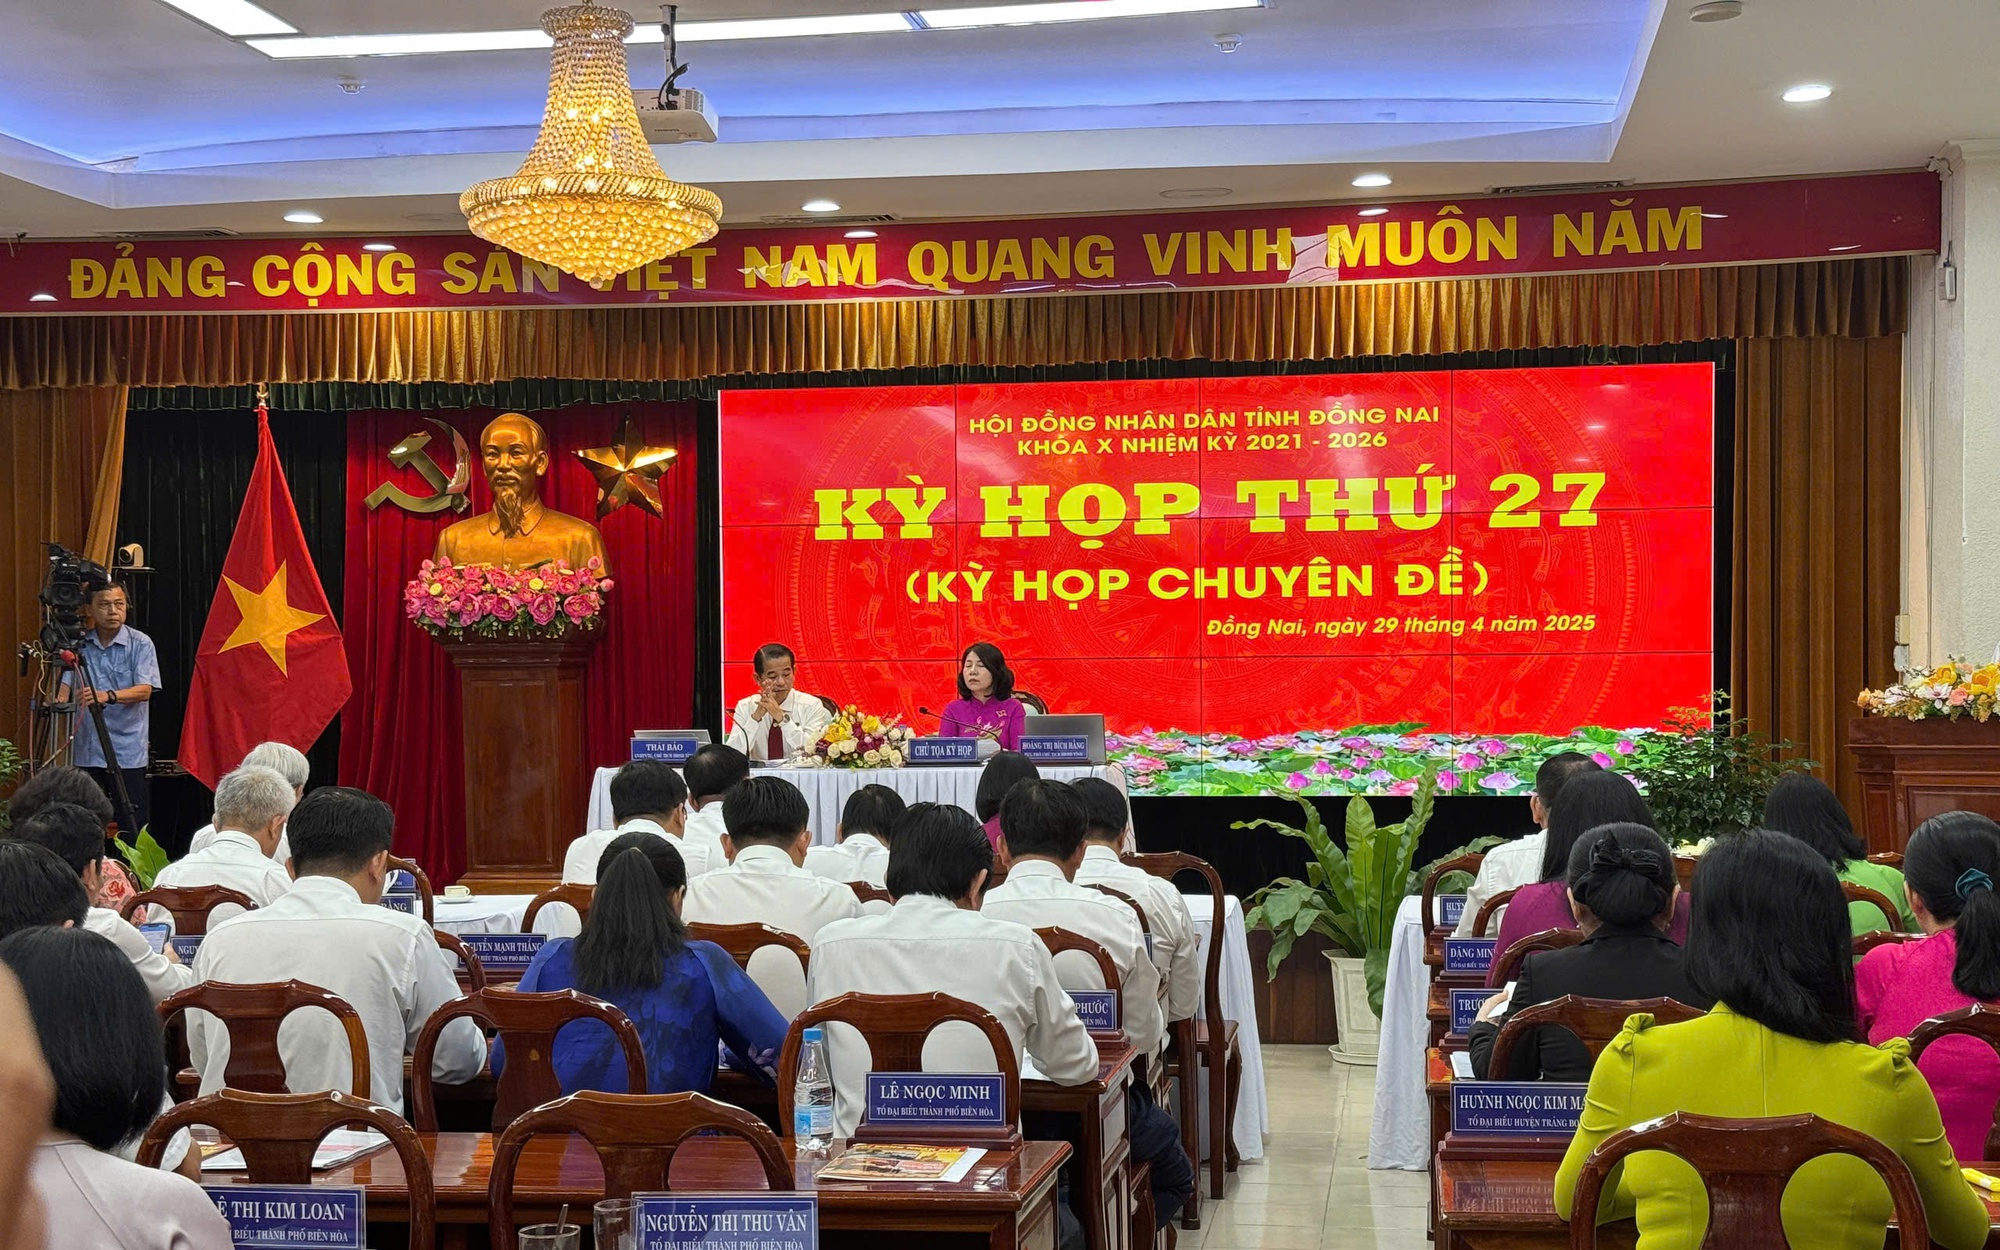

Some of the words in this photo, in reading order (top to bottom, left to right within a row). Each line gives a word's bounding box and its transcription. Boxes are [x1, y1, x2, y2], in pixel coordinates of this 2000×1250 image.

[68, 242, 225, 299] ĐẢNG
[252, 242, 416, 307] CỘNG
[743, 243, 878, 289] NAM
[907, 235, 1115, 291] QUANG
[1142, 227, 1293, 278] VINH
[1327, 205, 1517, 268] MUÔN
[1553, 197, 1703, 258] NĂM
[969, 413, 1013, 438] HỘI
[1021, 409, 1097, 433] ĐỒNG
[1104, 409, 1176, 431] NHÂN
[1183, 408, 1236, 429] DÂN
[1244, 405, 1300, 428] TỈNH
[1308, 401, 1387, 426] ĐỒNG
[1395, 406, 1440, 423] NAI
[1017, 433, 1089, 456] KHÓA
[1096, 438, 1114, 454] X
[1121, 432, 1199, 457] NHIỆM
[1207, 430, 1238, 451] KỲ
[1246, 433, 1302, 451] 2021
[1327, 431, 1388, 449] 2026
[814, 475, 947, 541] KỲ
[979, 482, 1201, 550] HỌP
[1236, 463, 1456, 533] THỨ
[1488, 472, 1607, 529] 27
[906, 561, 994, 604] (KỲ
[1013, 568, 1130, 610] HỌP
[1147, 556, 1373, 600] CHUYÊN
[1393, 546, 1489, 597] ĐỀ)
[1206, 614, 1262, 640] Đồng
[1267, 618, 1307, 637] Nai,
[1314, 618, 1365, 640] ngày
[1373, 617, 1399, 634] 29
[1404, 616, 1466, 639] tháng
[1471, 616, 1485, 633] 4
[1490, 615, 1538, 633] năm
[1544, 614, 1596, 632] 2025
[914, 742, 930, 756] CHỦ
[931, 745, 945, 758] TỌA
[946, 742, 957, 756] KỲ
[957, 745, 973, 758] HỌP
[1446, 900, 1465, 911] HUỲN
[178, 945, 199, 955] NGUY
[468, 938, 493, 952] GUYỄN
[494, 942, 516, 954] MẠNH
[1450, 946, 1475, 961] ĐẶNG
[1476, 948, 1496, 958] MIN
[1075, 999, 1109, 1014] PHƯỚC
[880, 1081, 900, 1099] LÊ
[903, 1085, 946, 1103] NGỌC
[949, 1085, 990, 1100] MINH
[1460, 1090, 1503, 1109] HUỲNH
[1506, 1095, 1541, 1114] NGỌC
[1544, 1095, 1568, 1110] KIM
[877, 1103, 886, 1116] TỔ
[887, 1107, 900, 1117] ĐẠI
[901, 1103, 918, 1116] BIỂU
[919, 1105, 943, 1116] THÀNH
[944, 1105, 960, 1116] PHỐ
[961, 1105, 978, 1116] BIÊN
[979, 1106, 994, 1117] HÒA
[1468, 1113, 1479, 1126] TỔ
[1480, 1117, 1493, 1128] ĐẠI
[1494, 1113, 1513, 1127] BIỂU
[1514, 1116, 1541, 1128] HUYỆN
[1541, 1115, 1568, 1127] TRẢNG
[1569, 1118, 1581, 1127] BO
[217, 1195, 228, 1218] Ê
[231, 1201, 261, 1222] THỊ
[264, 1202, 297, 1219] KIM
[301, 1202, 346, 1221] LOAN
[646, 1204, 708, 1232] NGUYỄN
[712, 1214, 739, 1236] THỊ
[741, 1214, 773, 1232] THU
[775, 1208, 807, 1232] VÂN
[234, 1224, 255, 1240] BIỂU
[256, 1227, 286, 1241] THÀNH
[288, 1227, 306, 1241] PHỐ
[307, 1228, 328, 1242] BIÊN
[330, 1231, 348, 1242] HÒA
[650, 1237, 663, 1250] TỔ
[682, 1236, 705, 1250] BIỂU
[706, 1238, 737, 1250] THÀNH
[740, 1237, 759, 1250] PHỐ
[786, 1238, 804, 1250] HÒA
